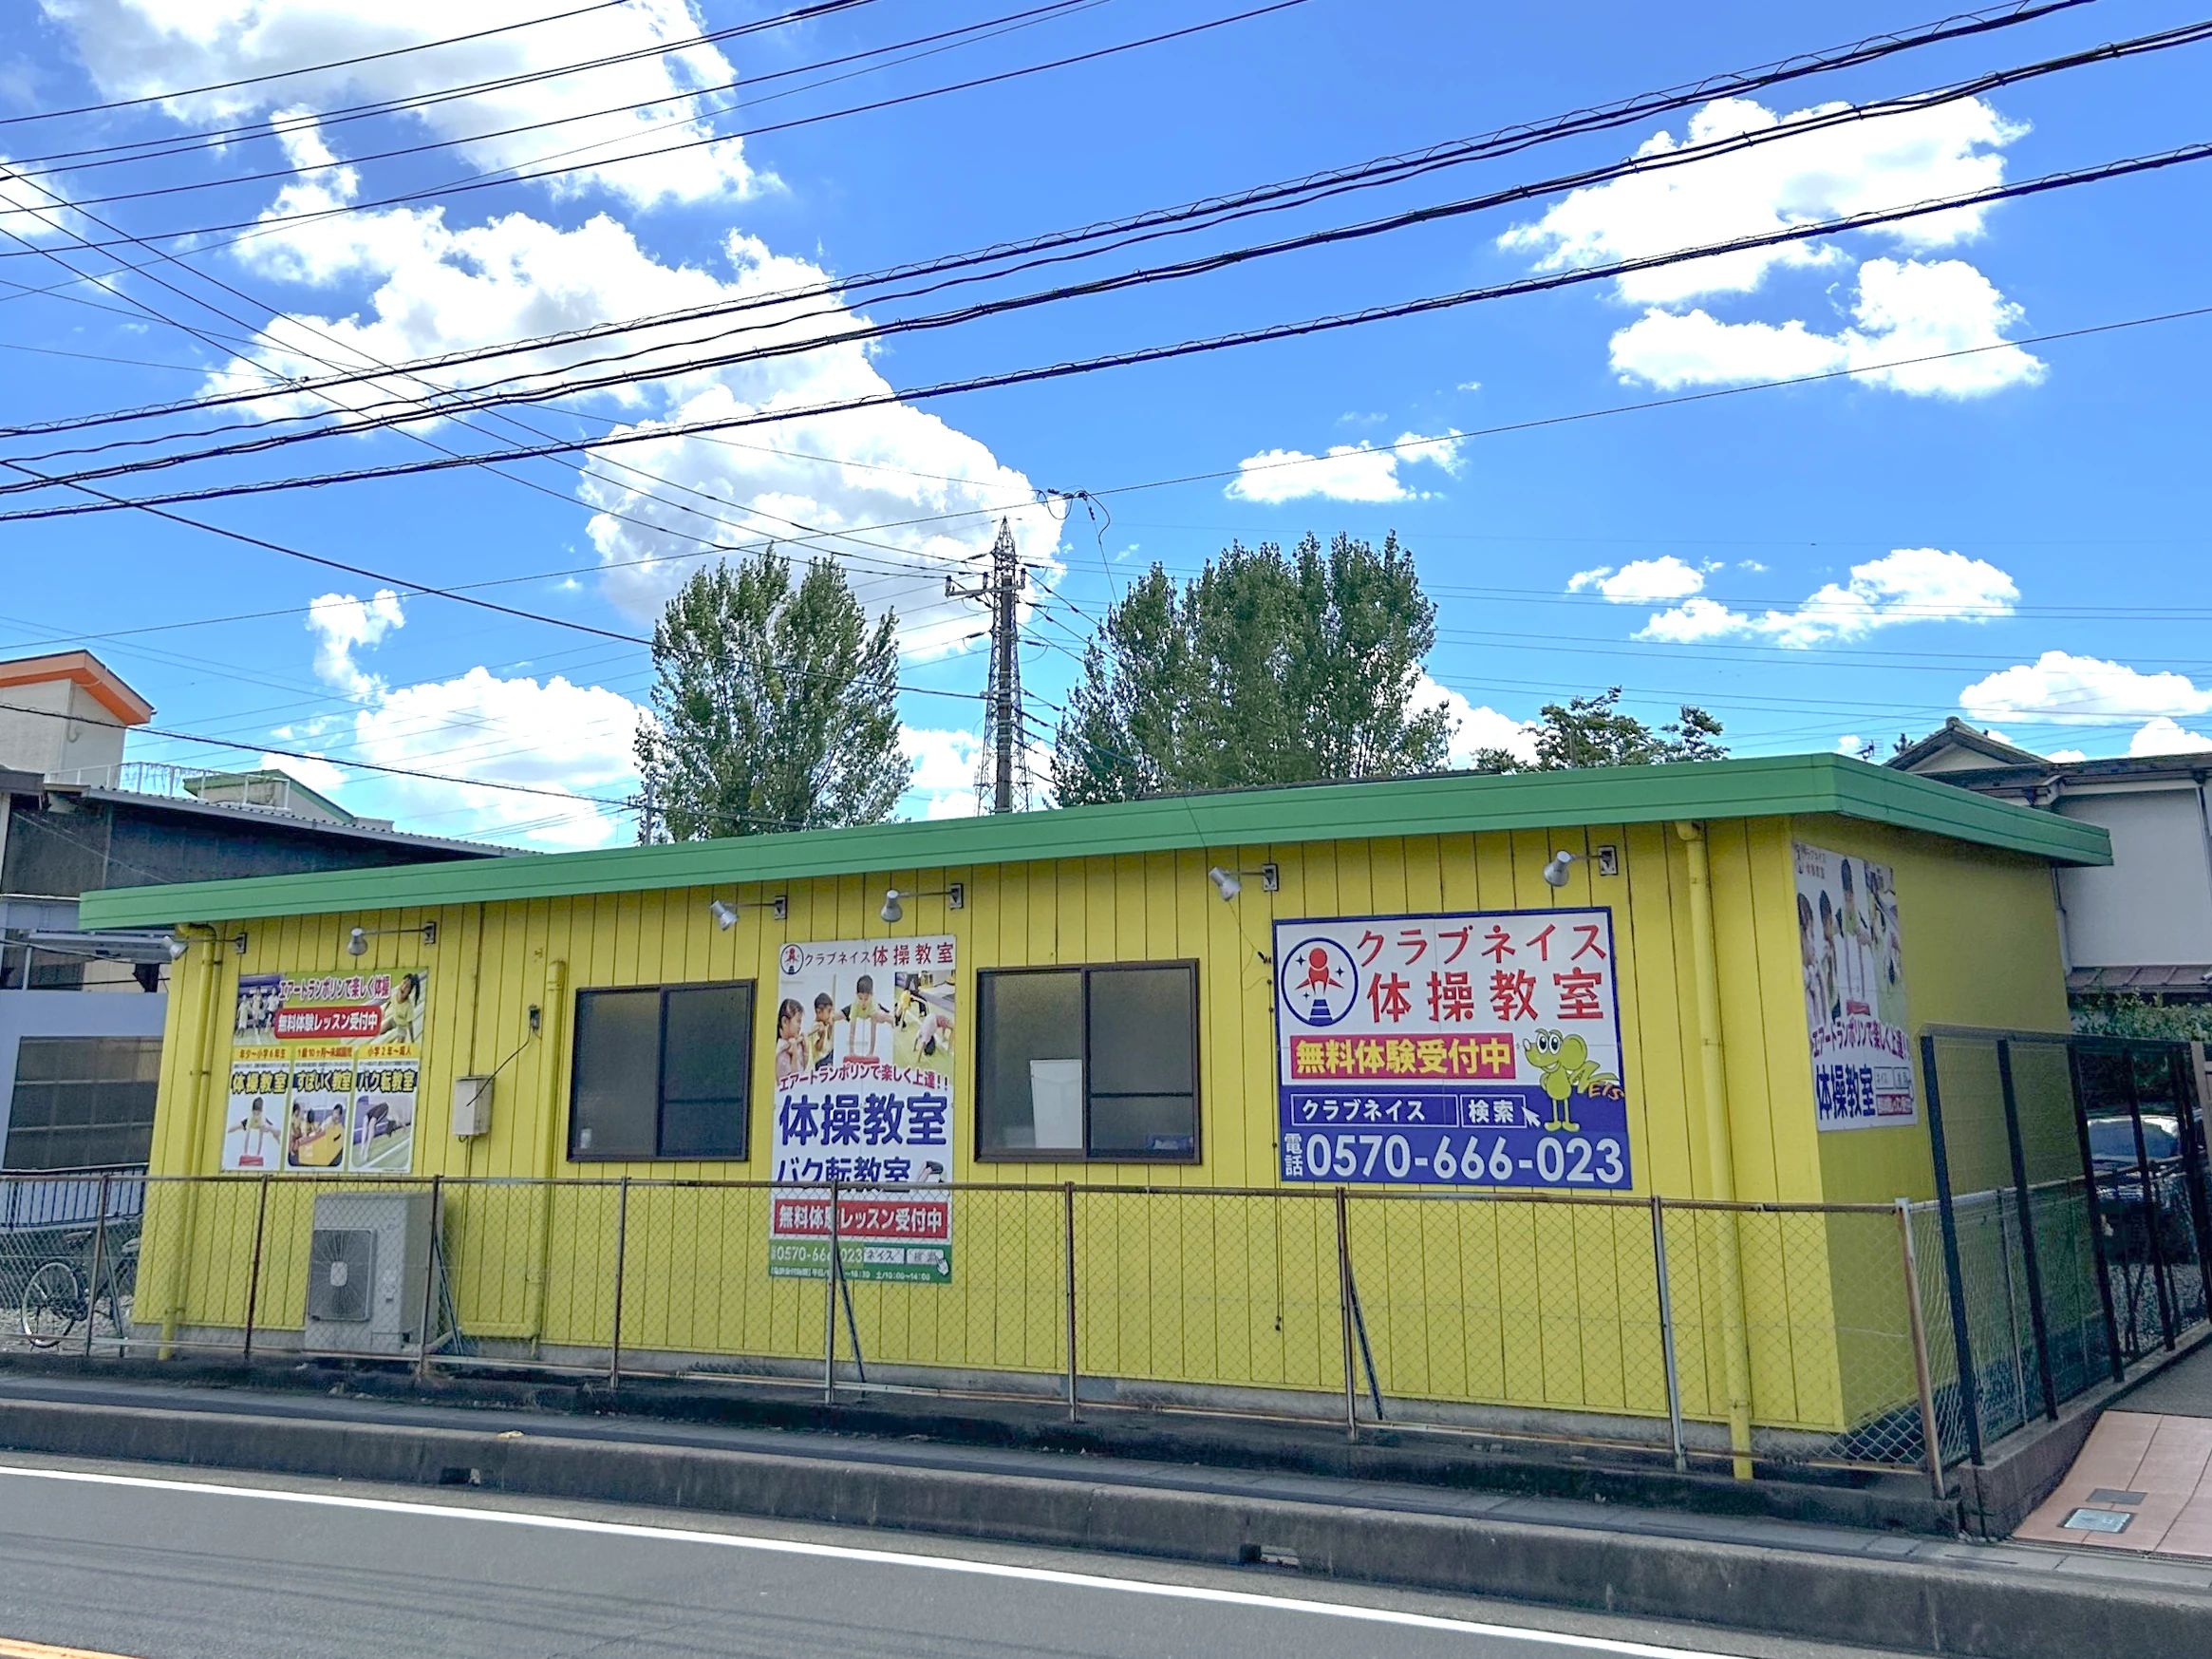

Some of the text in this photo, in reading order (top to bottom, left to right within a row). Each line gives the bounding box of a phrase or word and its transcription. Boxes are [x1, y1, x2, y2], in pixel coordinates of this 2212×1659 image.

[1356, 923, 1607, 967] クラブネイス
[1366, 967, 1604, 1023] 体操教室
[277, 1011, 379, 1032] 無料体験レッスン受付中
[1295, 1040, 1511, 1075] 無料体験受付中
[232, 1069, 289, 1093] 体操教室
[1815, 1064, 1876, 1121] 体操教室
[778, 1092, 947, 1145] 体操教室
[1302, 1099, 1426, 1122] クラブネイス
[1468, 1099, 1514, 1123] 検索
[1284, 1133, 1624, 1183] 電話 0570-666-023
